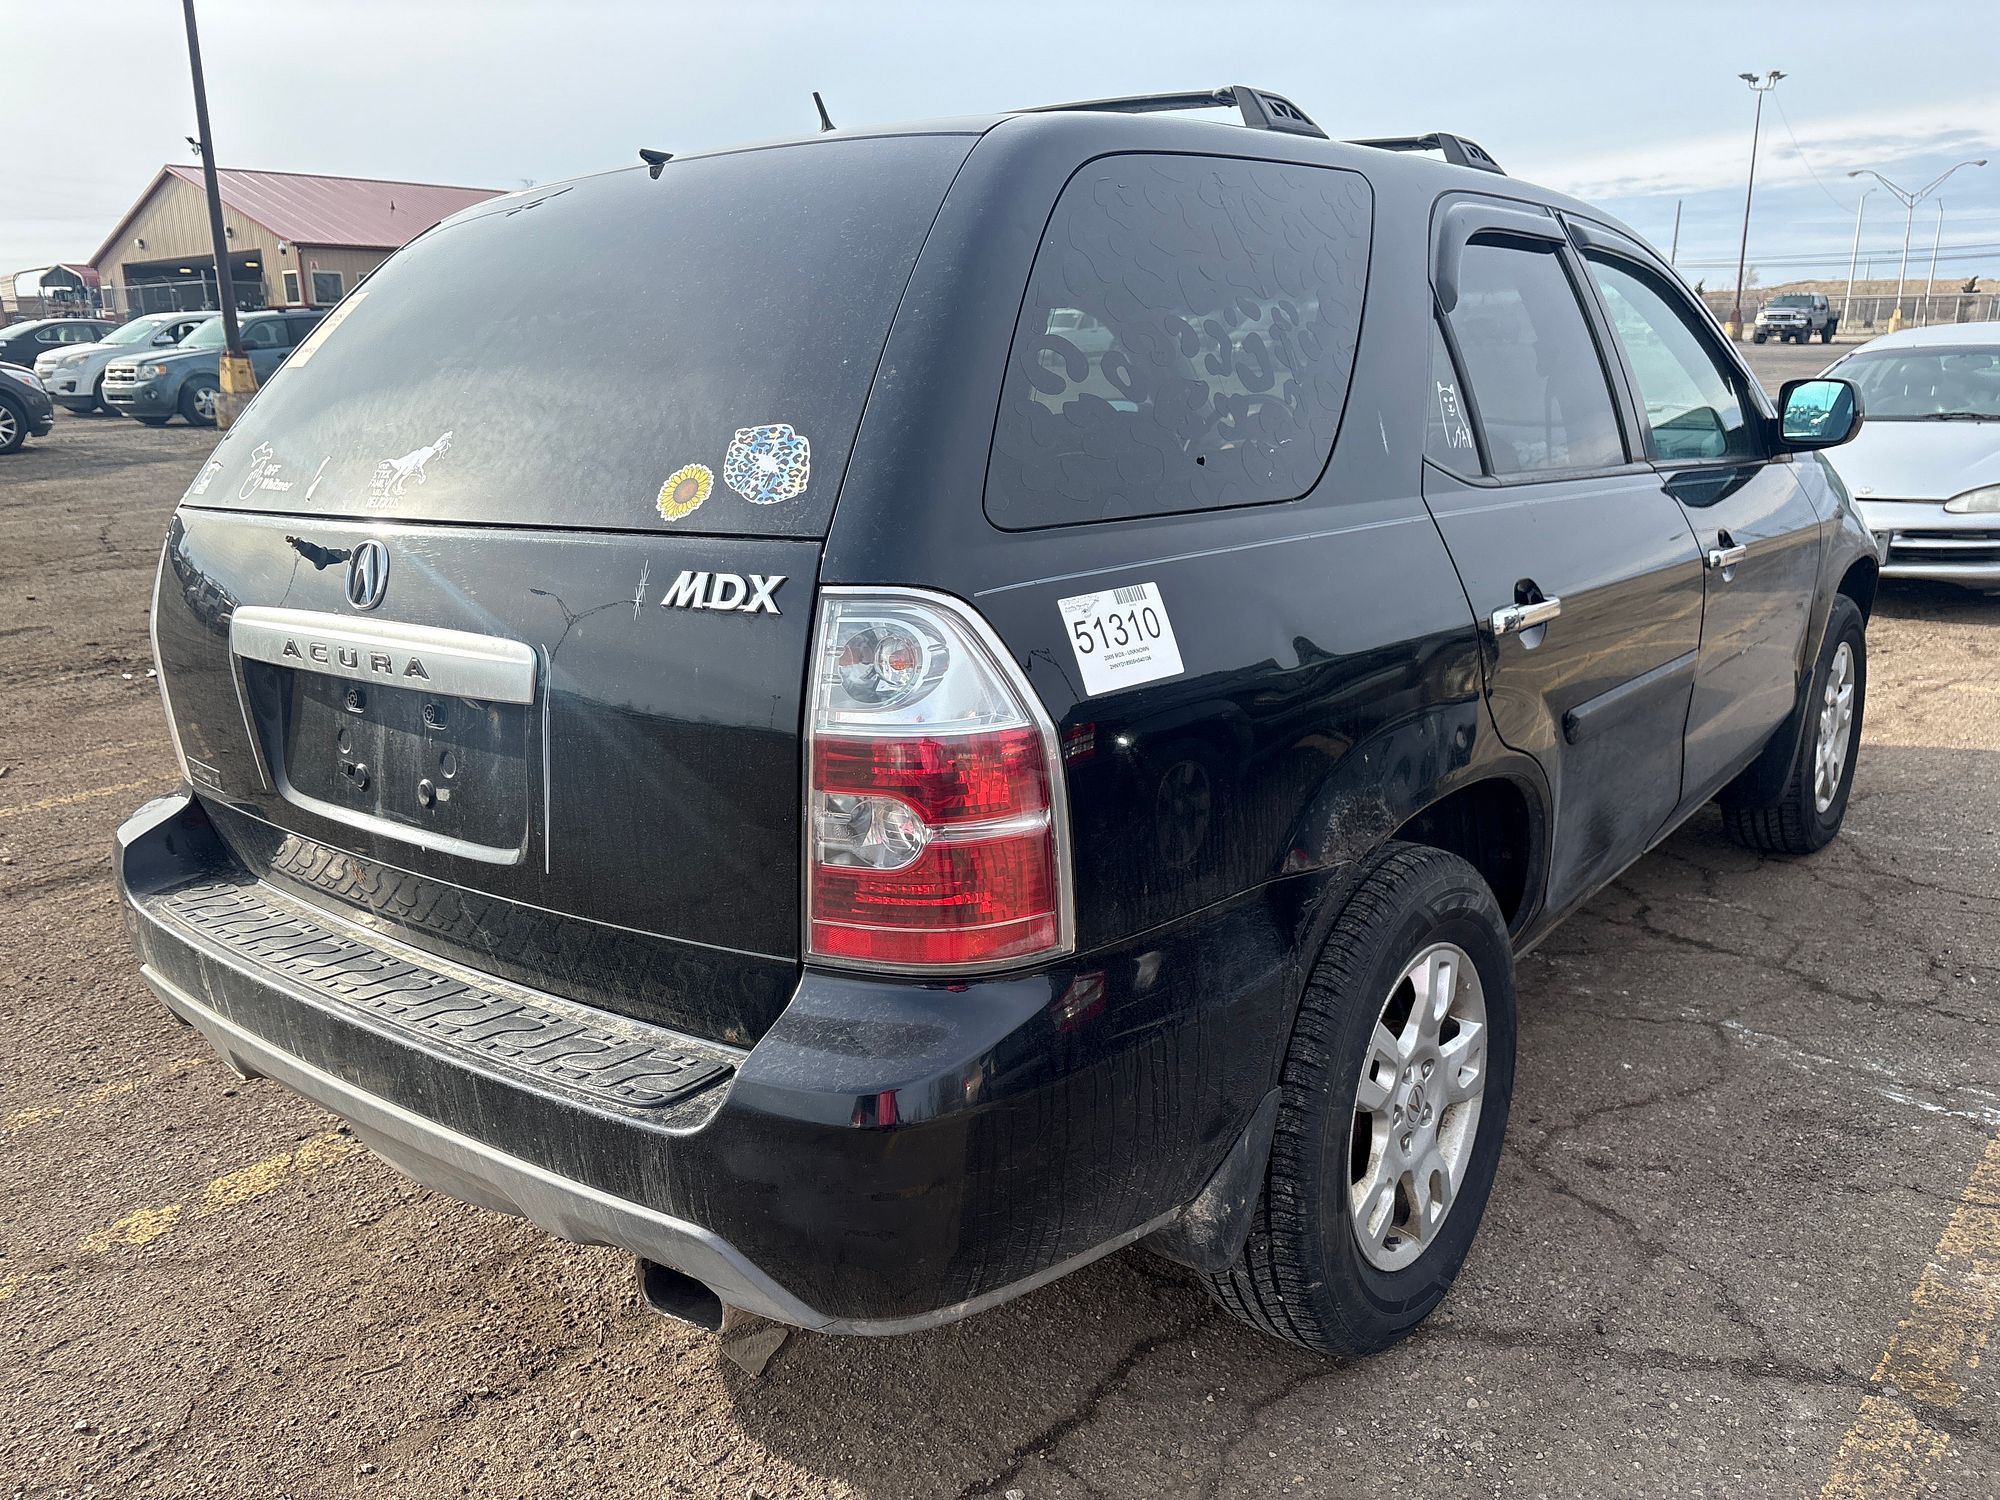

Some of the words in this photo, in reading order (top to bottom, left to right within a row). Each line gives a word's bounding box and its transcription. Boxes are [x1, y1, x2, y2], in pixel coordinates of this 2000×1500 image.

[263, 464, 282, 476] OFF
[660, 570, 789, 615] MDX
[1074, 607, 1160, 654] 51310
[1127, 646, 1150, 656] UNKNOWN
[282, 638, 430, 681] ACURA
